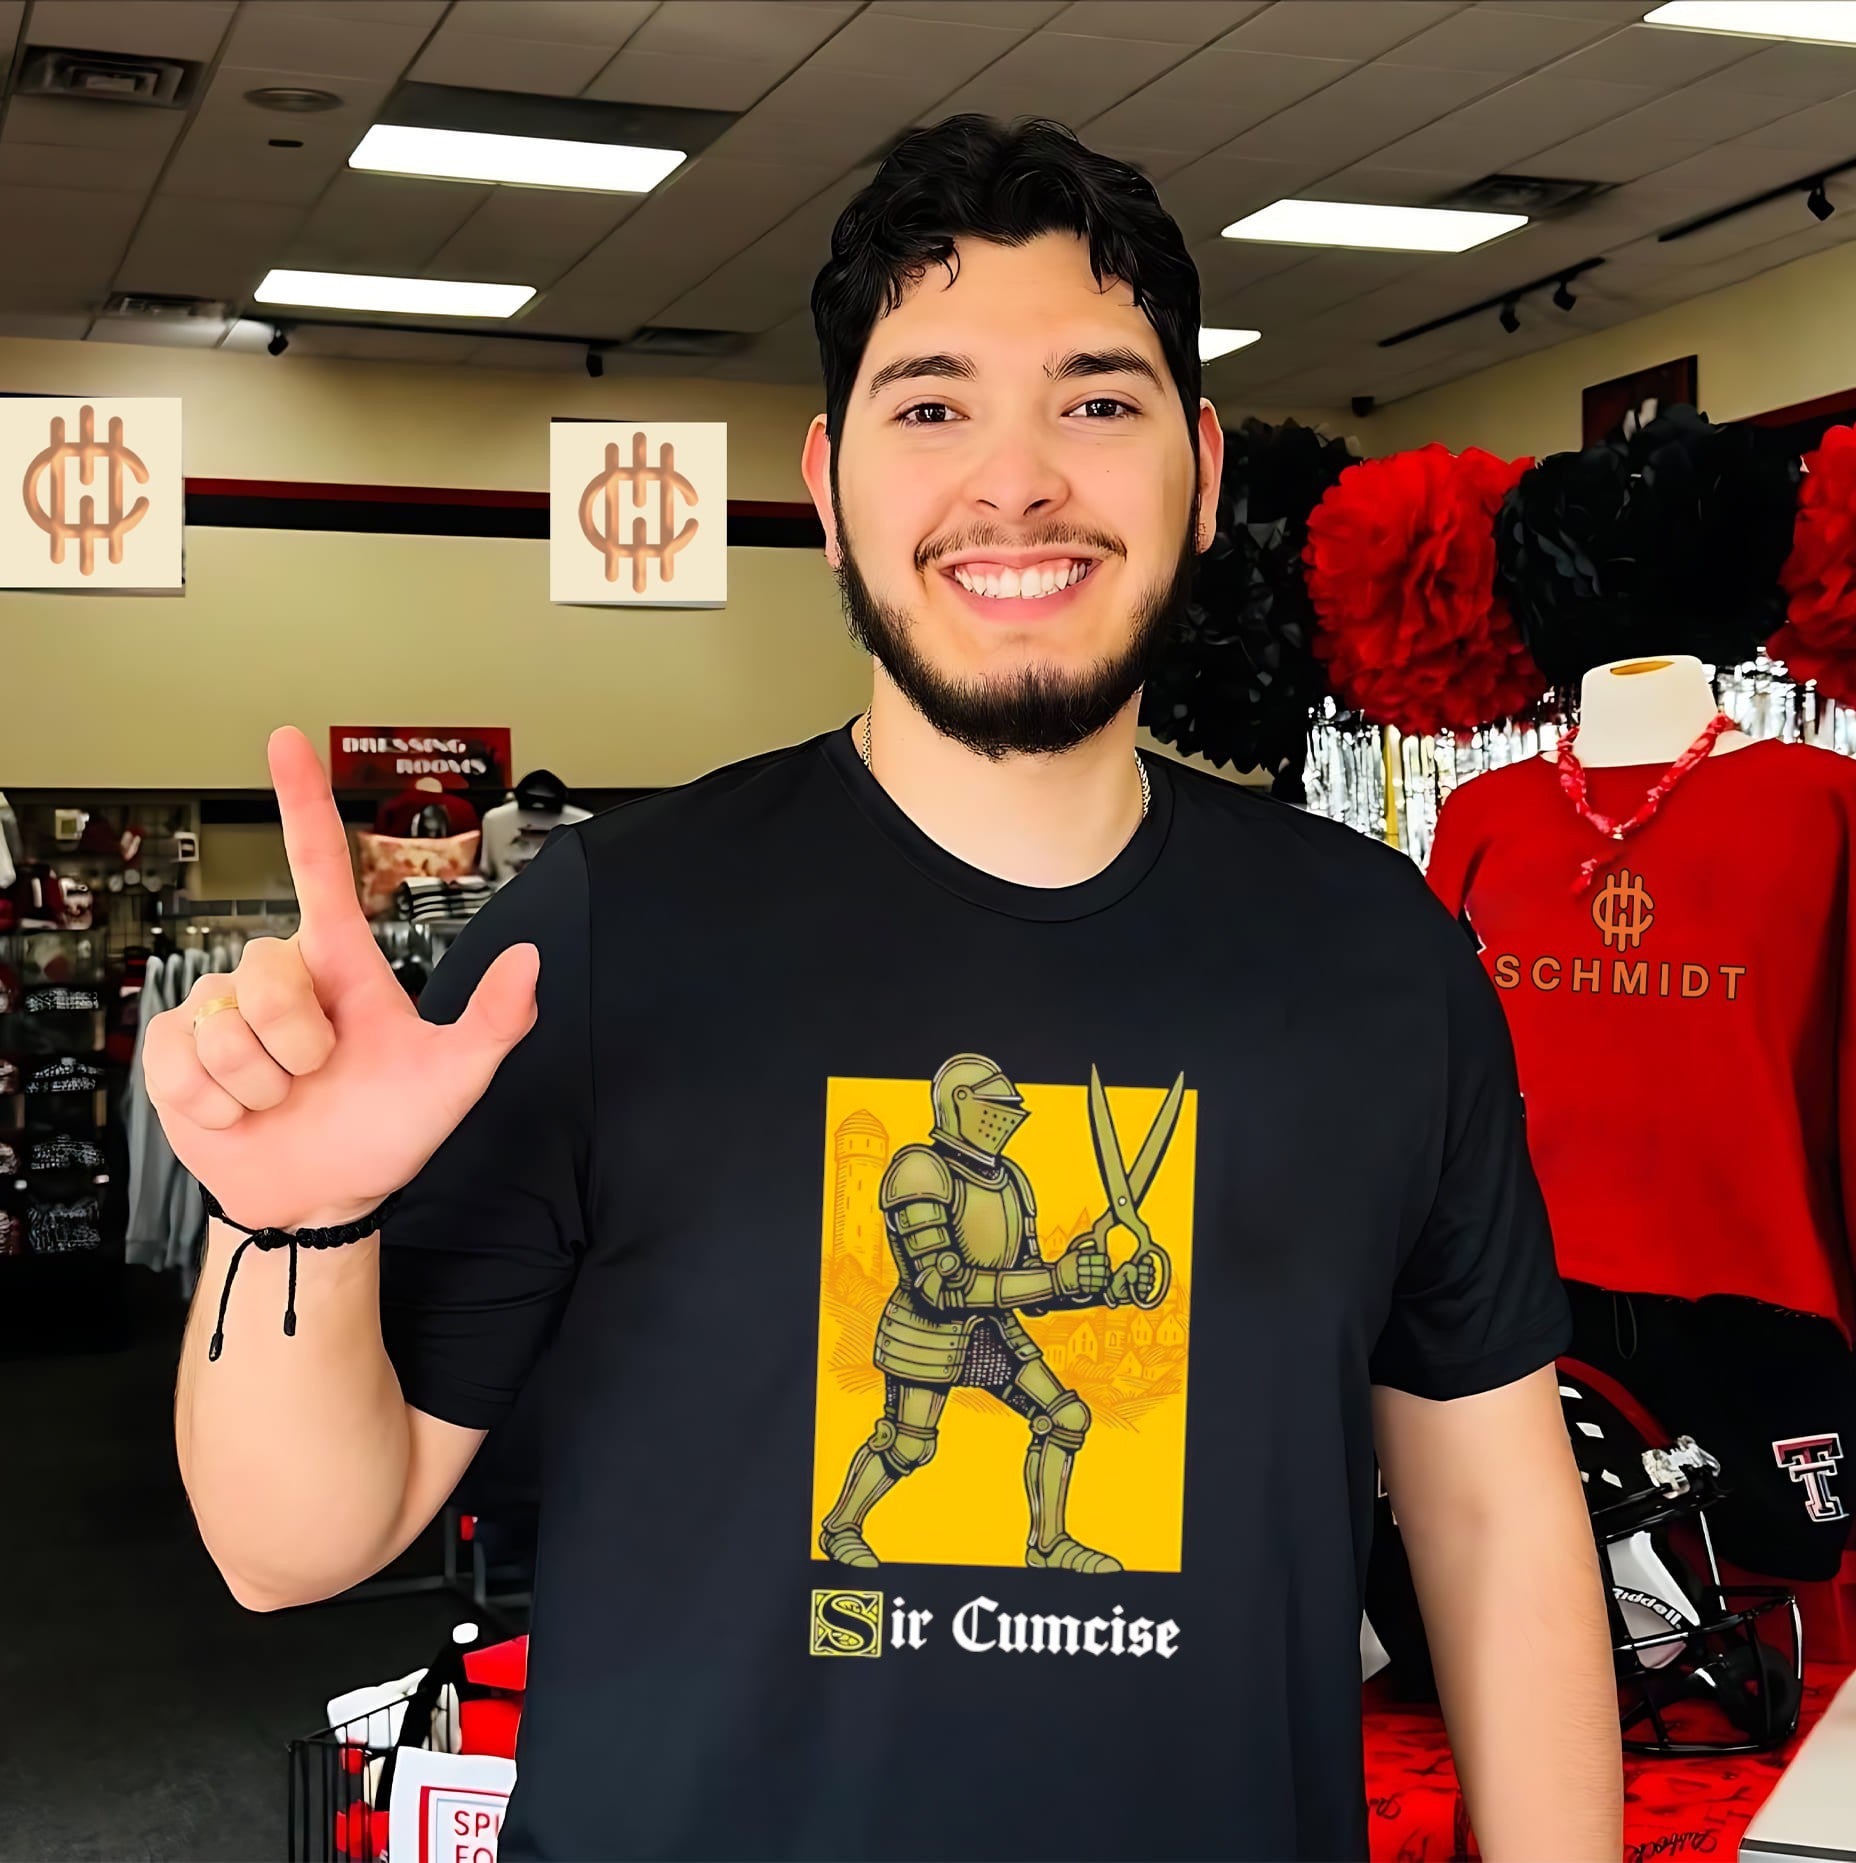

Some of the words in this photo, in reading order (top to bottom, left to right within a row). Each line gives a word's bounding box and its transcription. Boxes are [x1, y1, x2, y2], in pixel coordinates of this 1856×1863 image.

[396, 758, 487, 775] ROOMS
[1494, 954, 1747, 1001] SCHMIDT
[809, 1589, 933, 1658] Sir
[952, 1595, 1181, 1659] Cumcise
